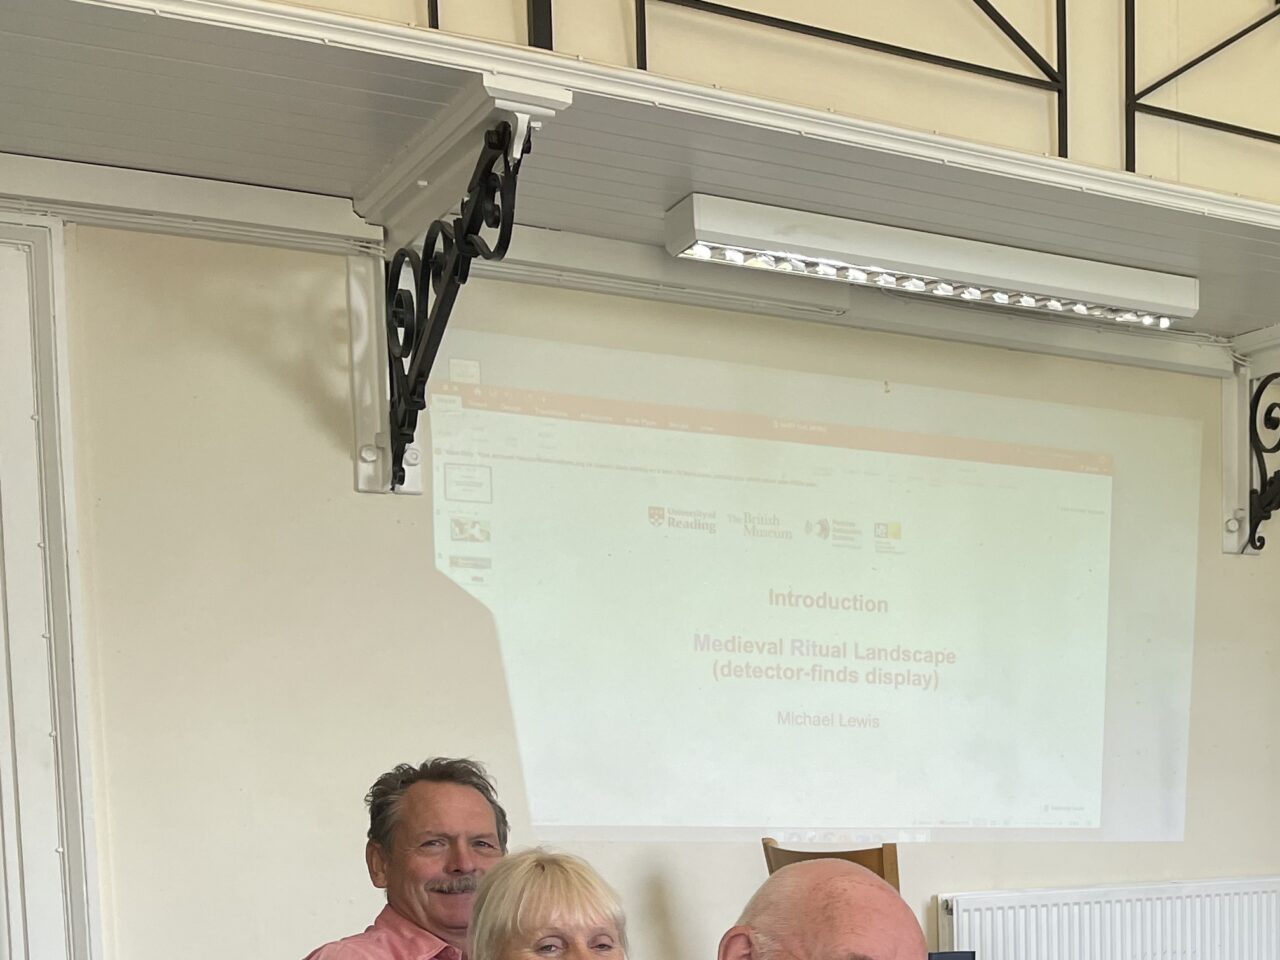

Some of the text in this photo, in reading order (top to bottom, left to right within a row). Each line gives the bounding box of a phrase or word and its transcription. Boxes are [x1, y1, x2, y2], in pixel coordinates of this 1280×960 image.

[667, 516, 717, 534] Reading
[744, 511, 780, 526] British
[743, 524, 793, 540] Museum
[768, 588, 889, 613] Introduction
[693, 634, 957, 666] Medieval Ritual Landscape
[712, 660, 940, 691] (detector-finds display)
[777, 710, 880, 728] Michael Lewis
